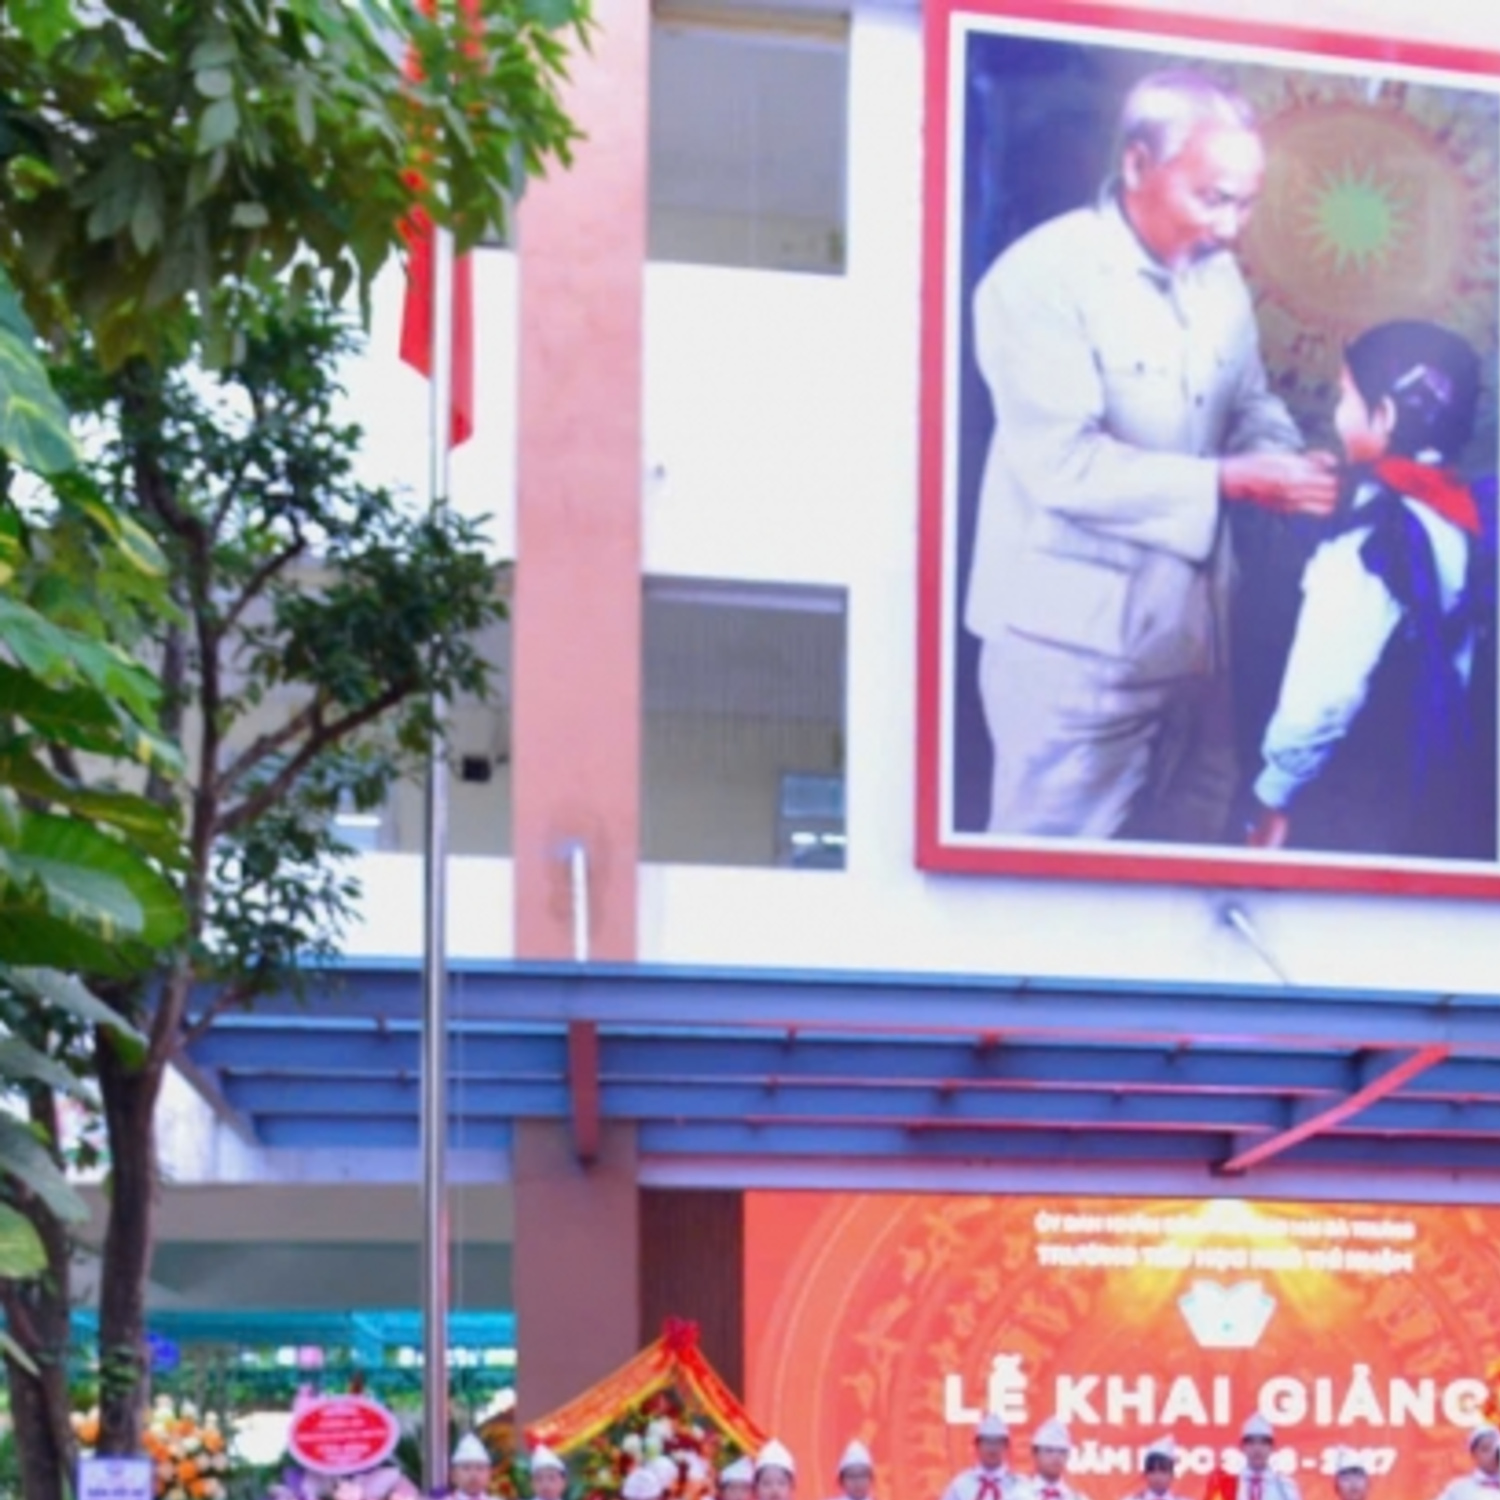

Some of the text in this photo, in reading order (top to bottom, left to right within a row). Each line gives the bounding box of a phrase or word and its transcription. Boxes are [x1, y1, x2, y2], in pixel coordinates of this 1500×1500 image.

[944, 1353, 1491, 1428] LỄ KHAI GIẢNG
